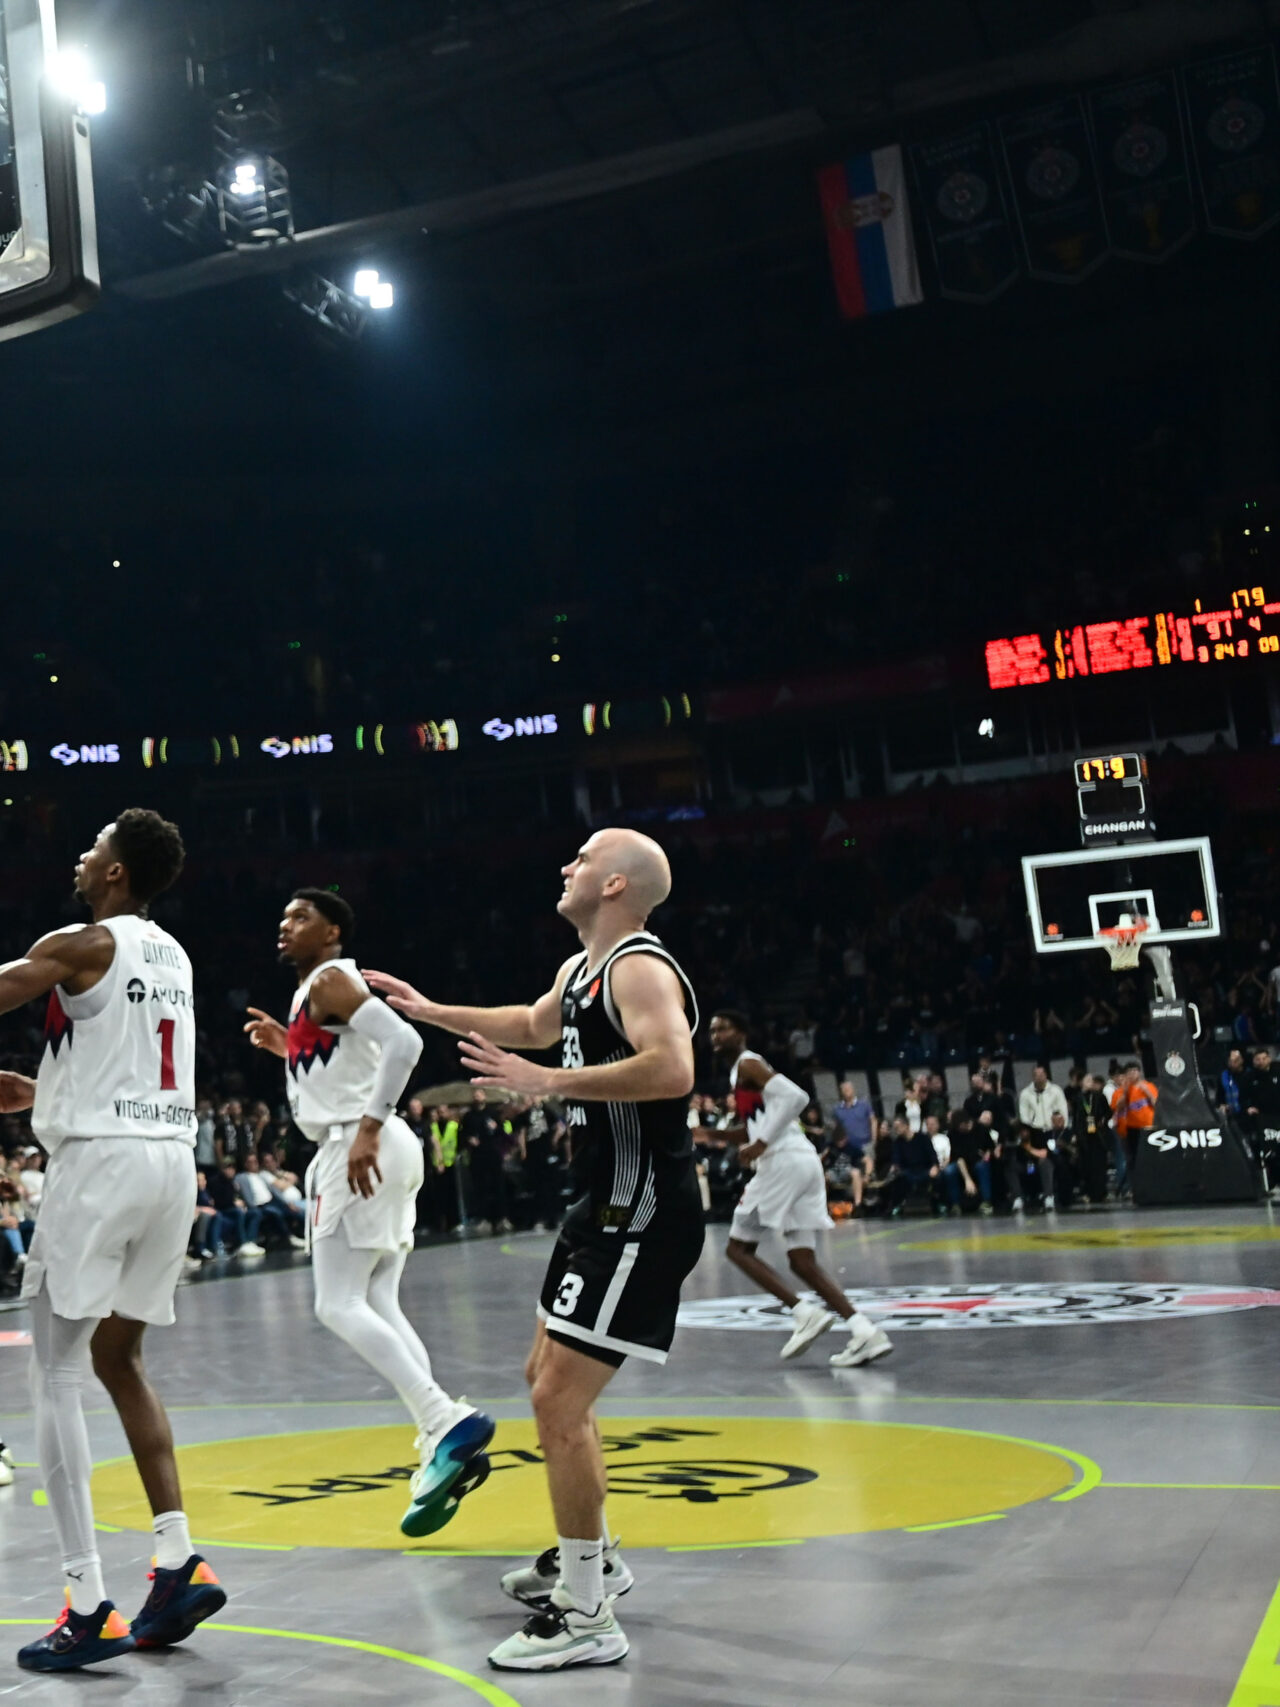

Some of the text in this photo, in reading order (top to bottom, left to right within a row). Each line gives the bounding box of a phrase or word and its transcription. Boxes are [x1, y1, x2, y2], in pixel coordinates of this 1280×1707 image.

[515, 714, 558, 736] NIS
[80, 743, 120, 763] NIS
[292, 734, 333, 754] NIS
[1084, 820, 1146, 836] CHANGAN
[156, 1018, 178, 1091] 1
[1180, 1128, 1222, 1149] NIS
